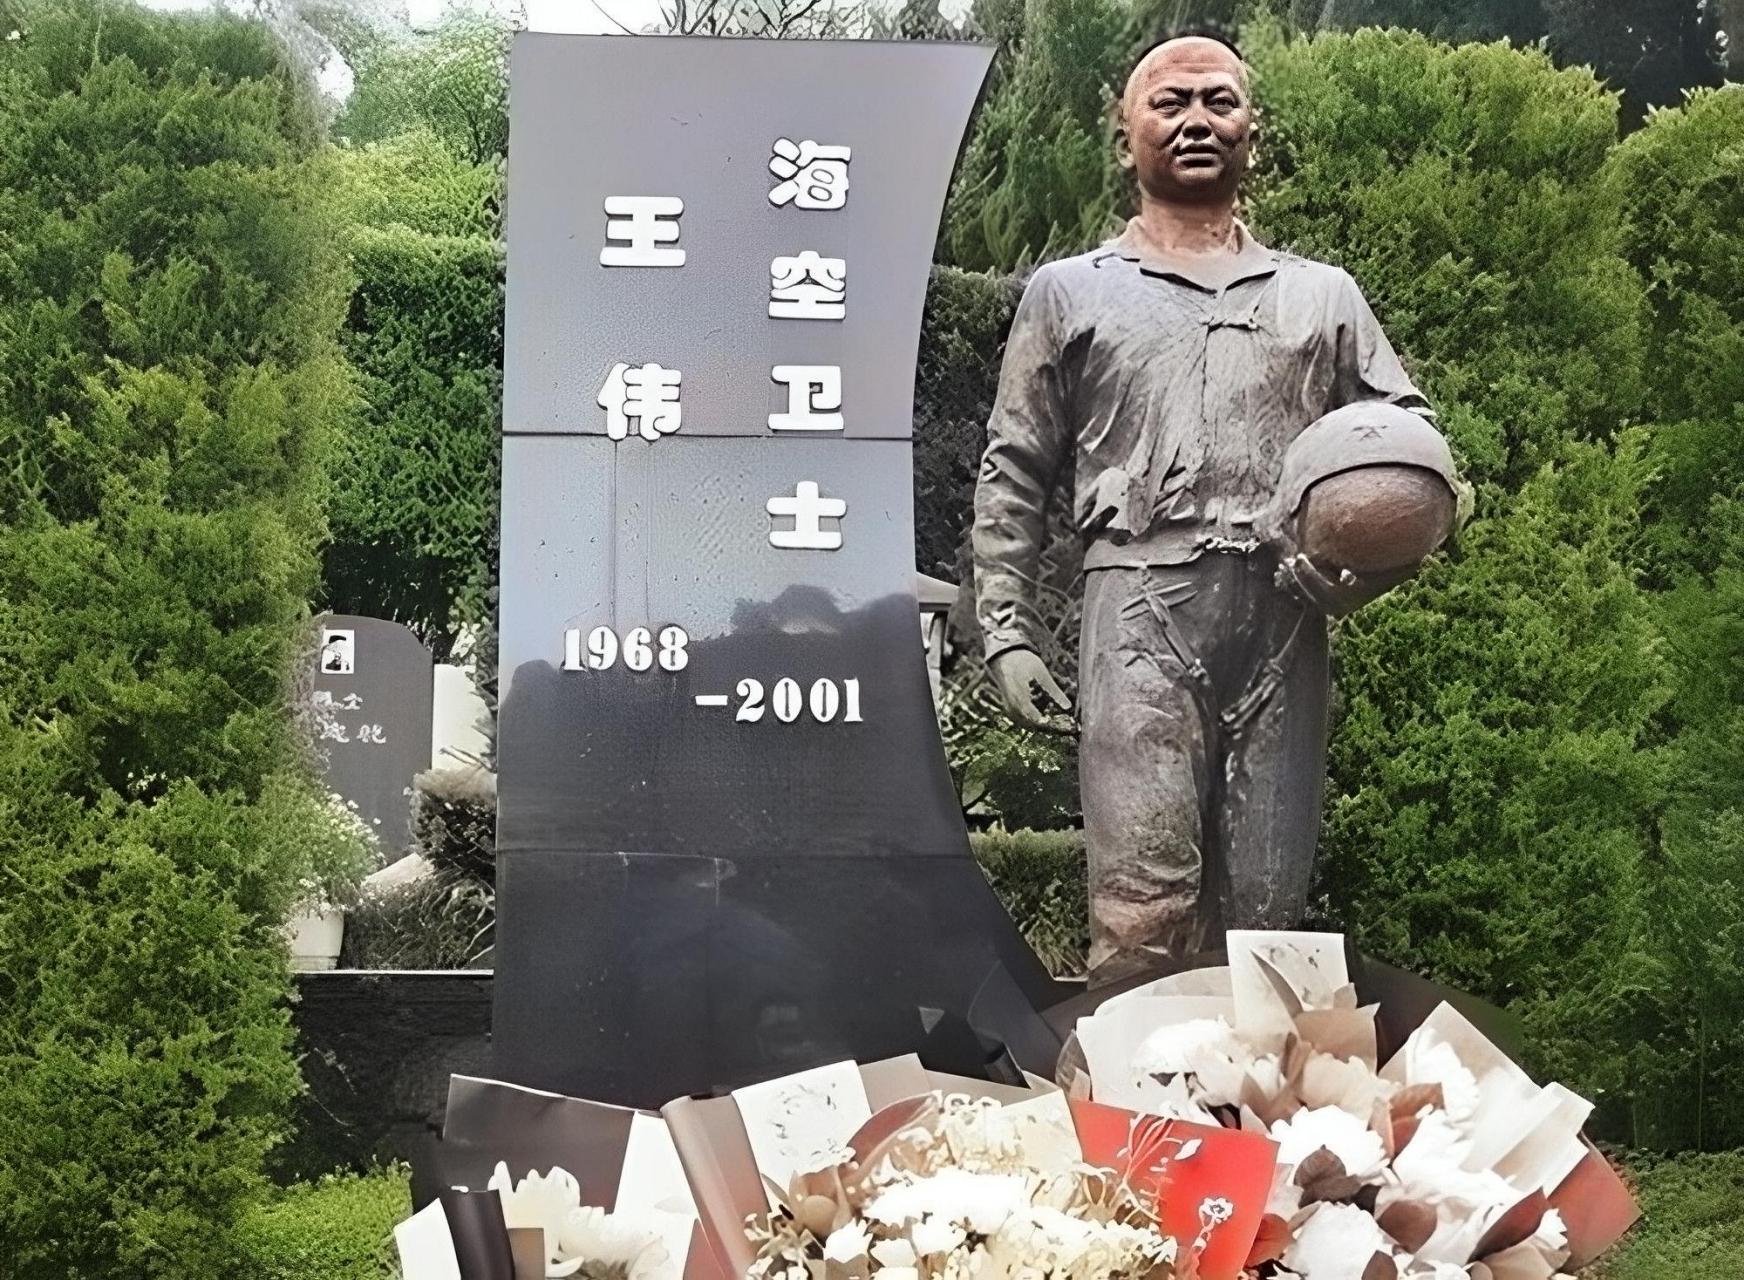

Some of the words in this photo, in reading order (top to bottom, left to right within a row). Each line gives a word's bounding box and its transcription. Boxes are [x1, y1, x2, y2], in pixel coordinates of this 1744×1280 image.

[597, 195, 686, 441] 王伟
[767, 137, 852, 550] 海空卫士
[563, 626, 689, 672] 1968
